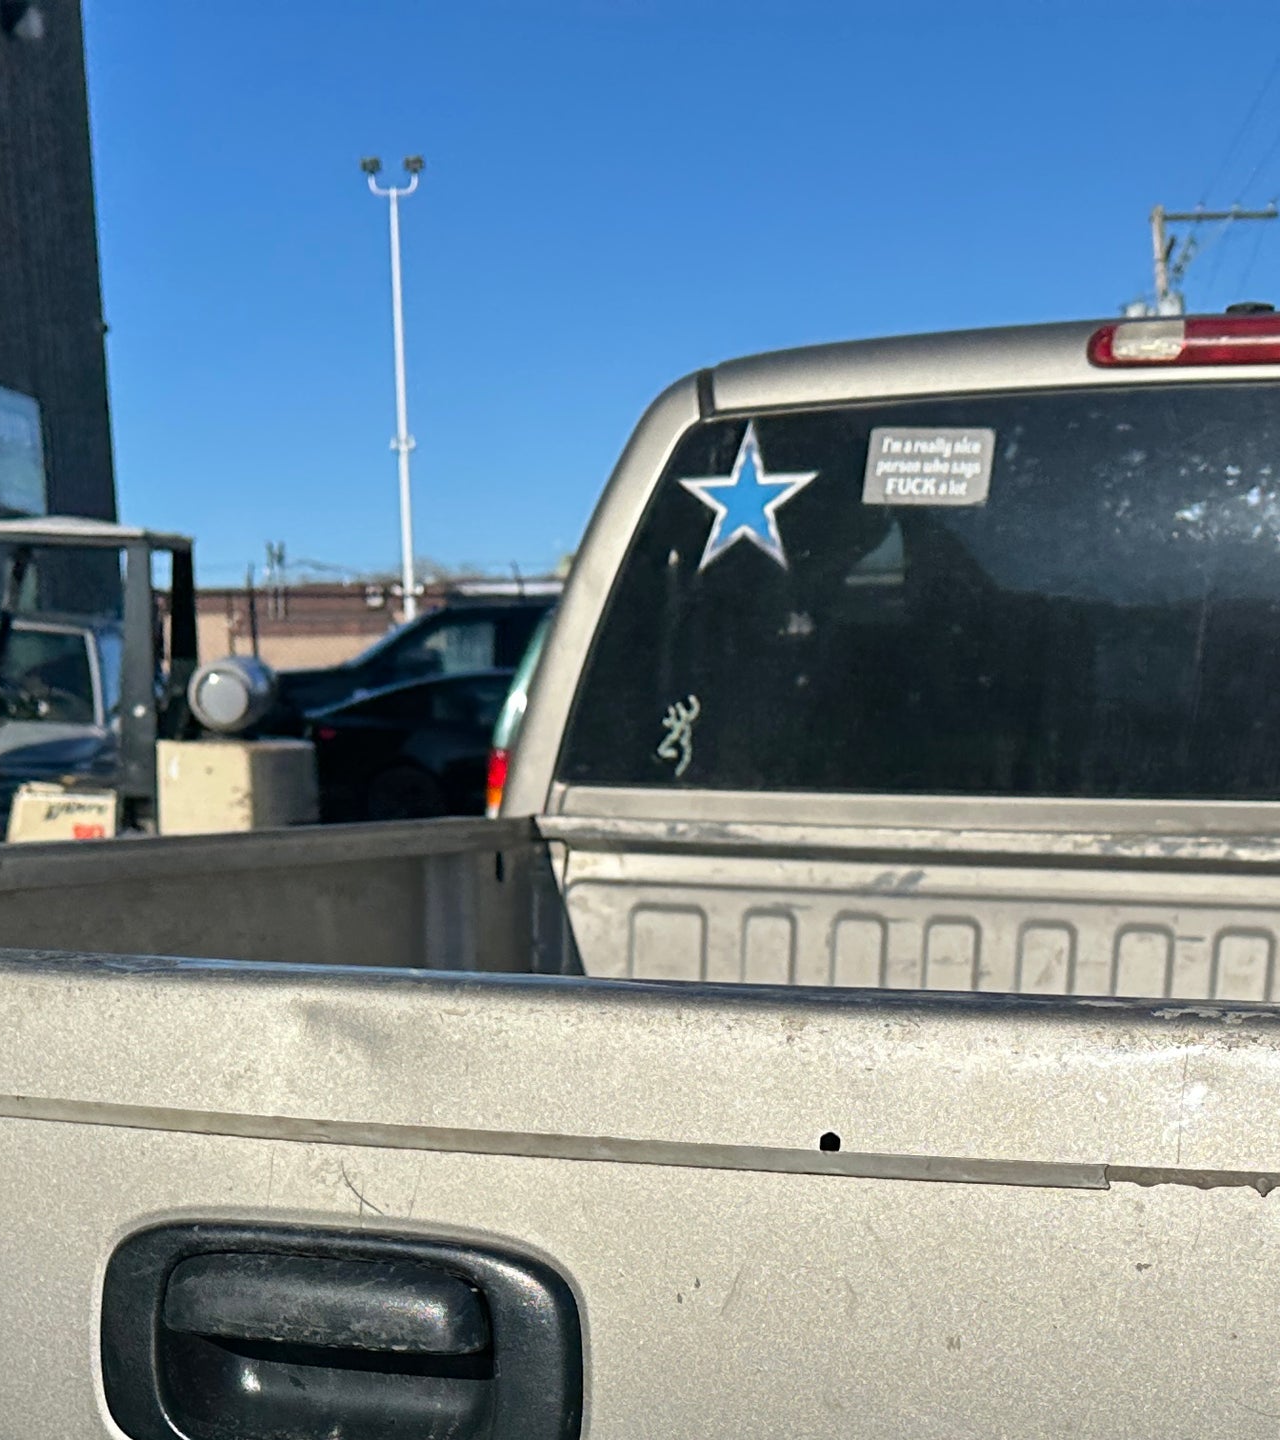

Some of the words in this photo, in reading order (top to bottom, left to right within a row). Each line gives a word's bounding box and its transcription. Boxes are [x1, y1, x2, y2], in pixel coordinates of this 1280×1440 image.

[913, 437, 952, 457] really
[875, 461, 921, 476] person
[923, 459, 950, 474] who
[951, 461, 982, 479] says
[885, 478, 936, 495] FUCK
[938, 482, 948, 495] a
[948, 480, 968, 496] lot
